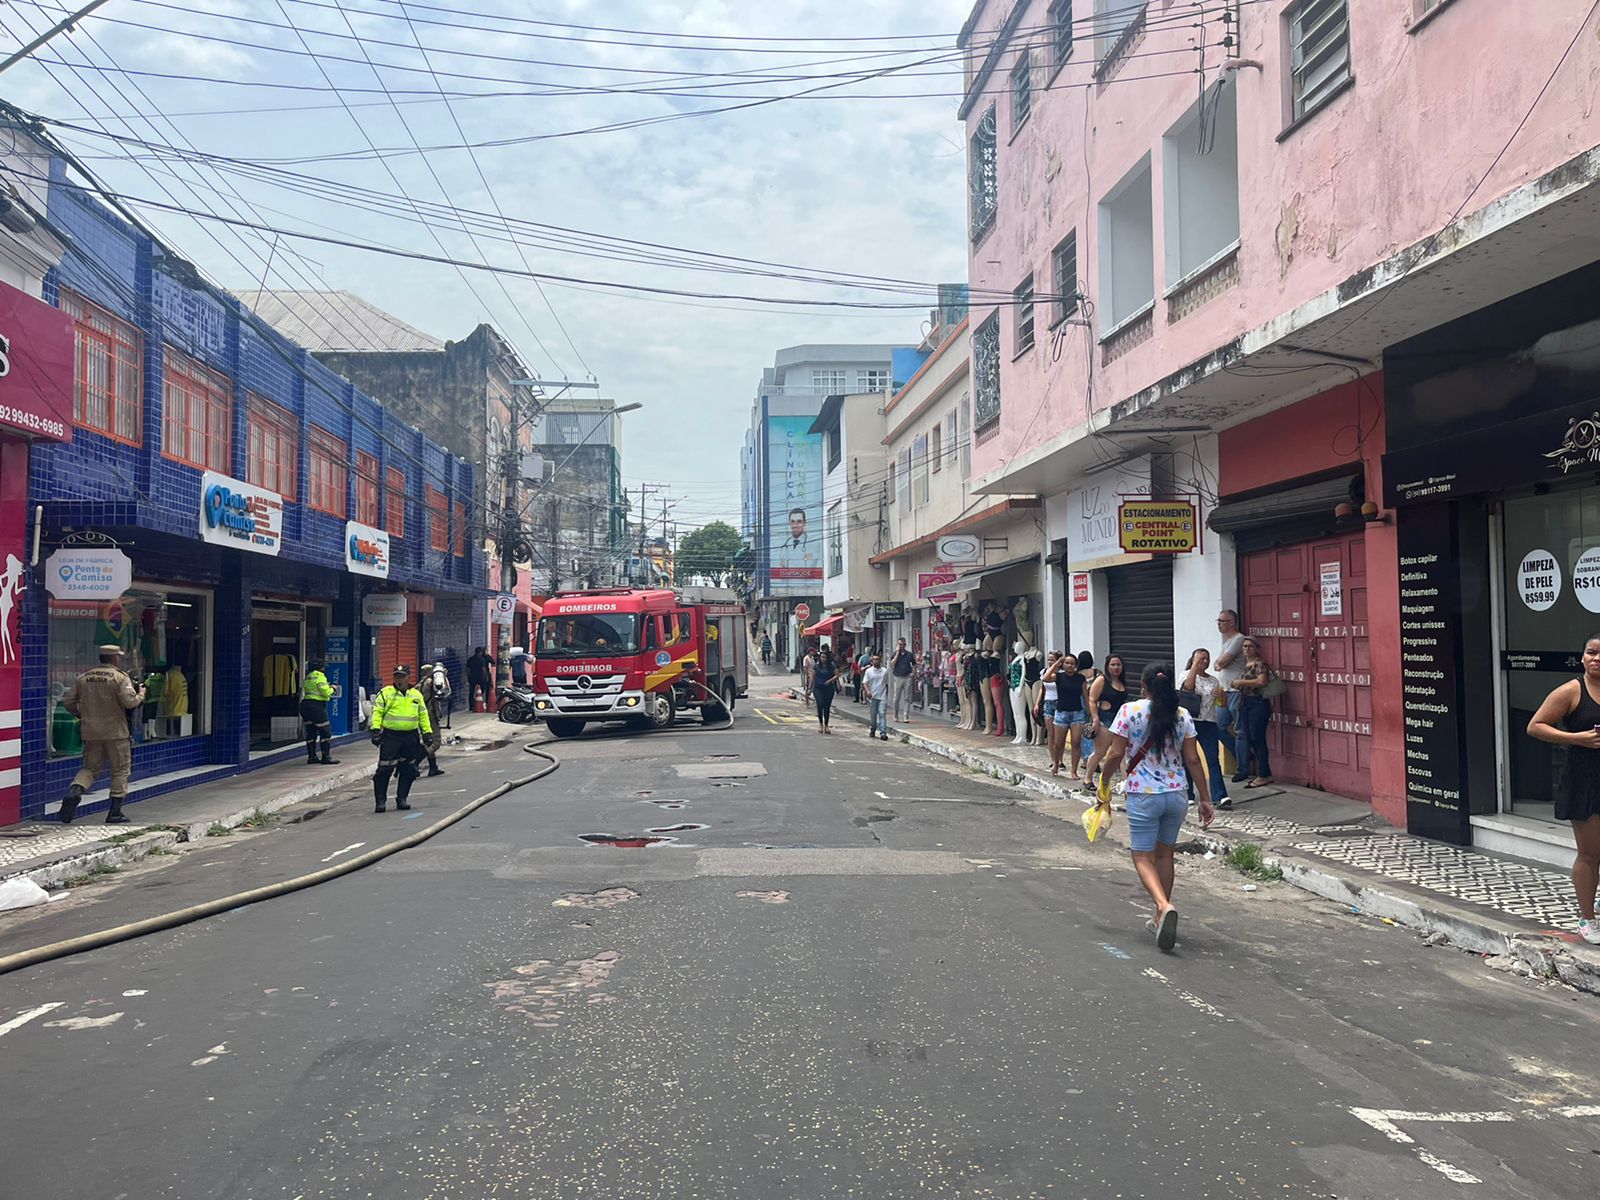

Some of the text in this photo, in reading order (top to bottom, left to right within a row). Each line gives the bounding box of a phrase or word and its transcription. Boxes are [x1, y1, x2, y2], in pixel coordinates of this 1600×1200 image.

[0, 405, 63, 437] 92 99432-6985
[1081, 486, 1101, 519] LUZ
[1123, 508, 1191, 518] ESTACIONAMENTO
[1082, 515, 1116, 544] MUNDO
[1135, 521, 1180, 529] CENTRAL
[1131, 539, 1188, 547] ROTATIVO
[1400, 554, 1438, 565] Botox capilar
[75, 565, 101, 573] Ponto
[1523, 559, 1554, 573] LIMPEZA
[75, 572, 113, 582] Camisa
[1401, 572, 1427, 581] Definitiva
[1525, 576, 1553, 589] DE PELE
[1401, 588, 1438, 597] Relaxamento
[500, 600, 508, 610] E
[559, 604, 617, 613] BOMBEIROS
[1402, 605, 1434, 614] Maquiagem
[1402, 620, 1445, 629] Cortes unissex
[1249, 627, 1298, 637] ESTACIONAMENTO
[1403, 637, 1437, 647] Progressiva
[1403, 653, 1434, 662] Penteados
[1404, 668, 1444, 679] Reconstrução
[1404, 685, 1436, 696] Hidratação
[1324, 720, 1370, 734] GUINCH
[1405, 717, 1434, 728] Mega hair
[1406, 733, 1423, 743] Luzes
[1407, 749, 1429, 760] Mechas
[1408, 765, 1432, 777] Escovas
[1408, 782, 1459, 799] Química em geral
